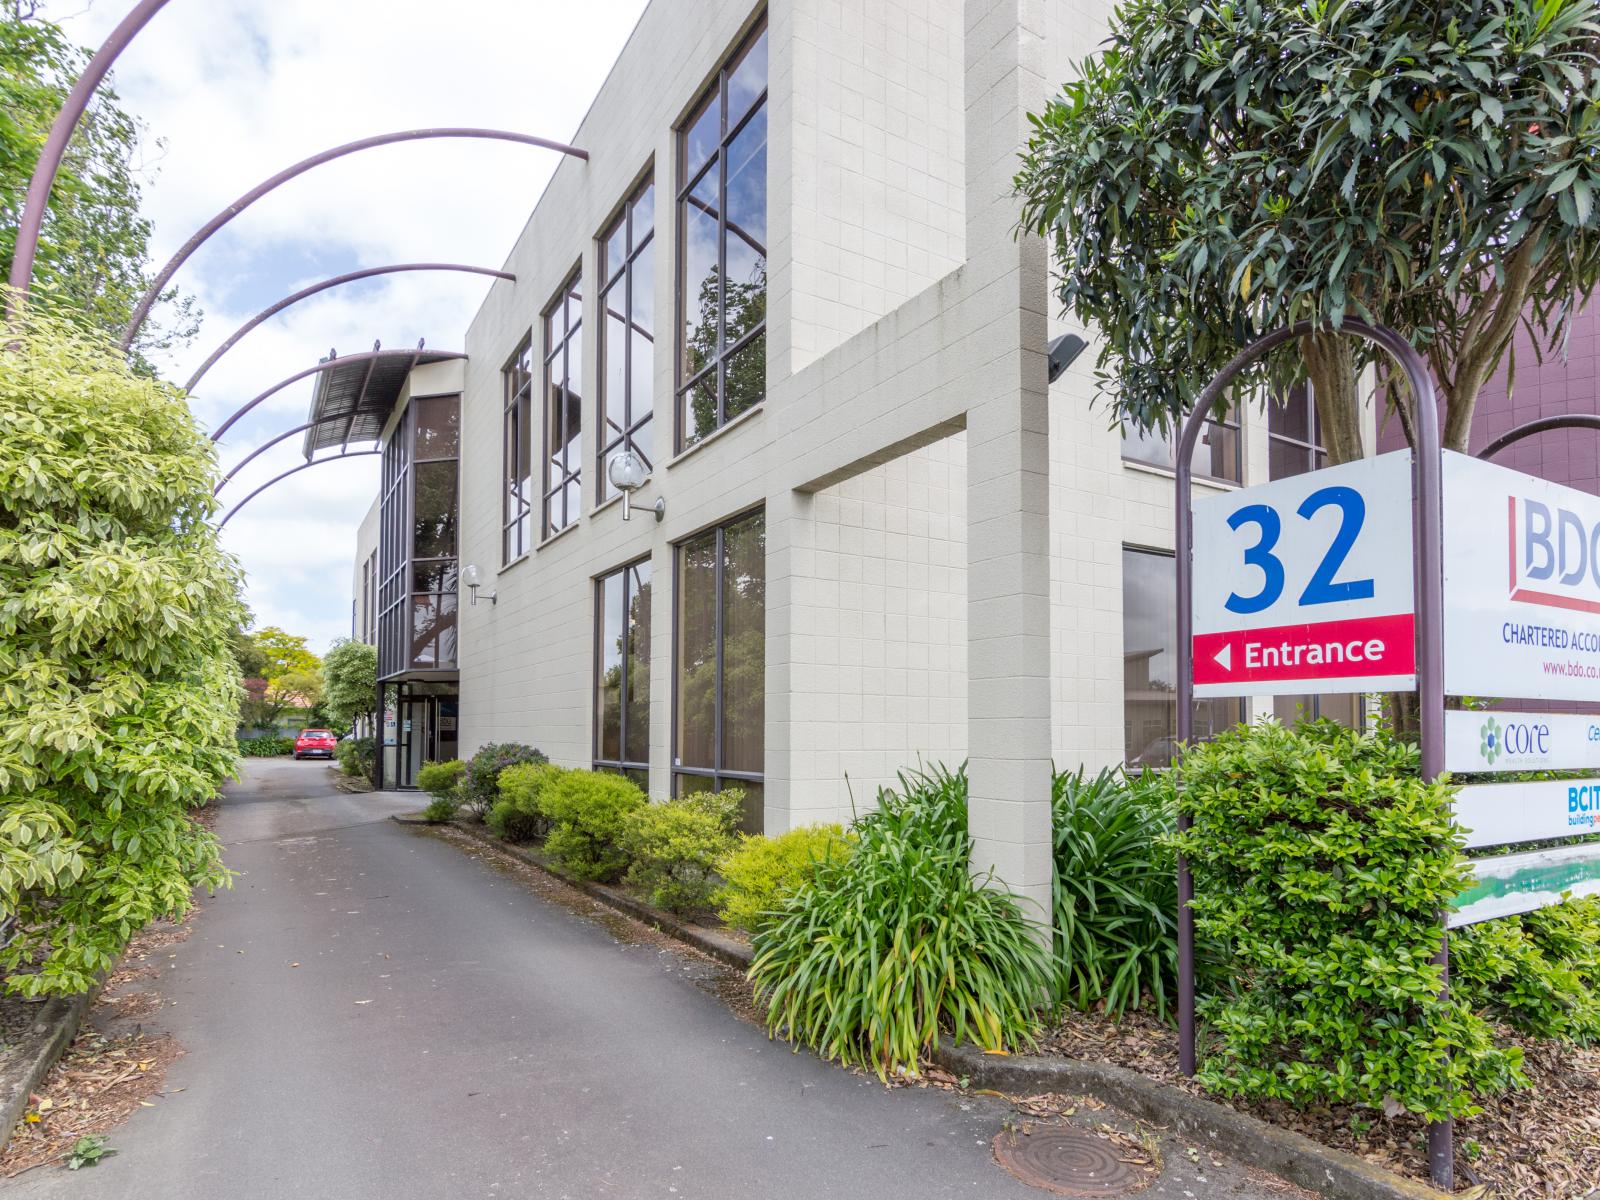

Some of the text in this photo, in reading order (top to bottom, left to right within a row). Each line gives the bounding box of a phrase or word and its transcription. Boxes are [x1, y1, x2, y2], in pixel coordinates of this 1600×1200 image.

[1224, 486, 1375, 615] 32
[1503, 622, 1600, 653] CHARTERED ACCO
[1245, 638, 1385, 669] Entrance
[1543, 659, 1600, 679] www.bdo.co.
[1505, 723, 1549, 754] core
[1588, 724, 1600, 741] Ce
